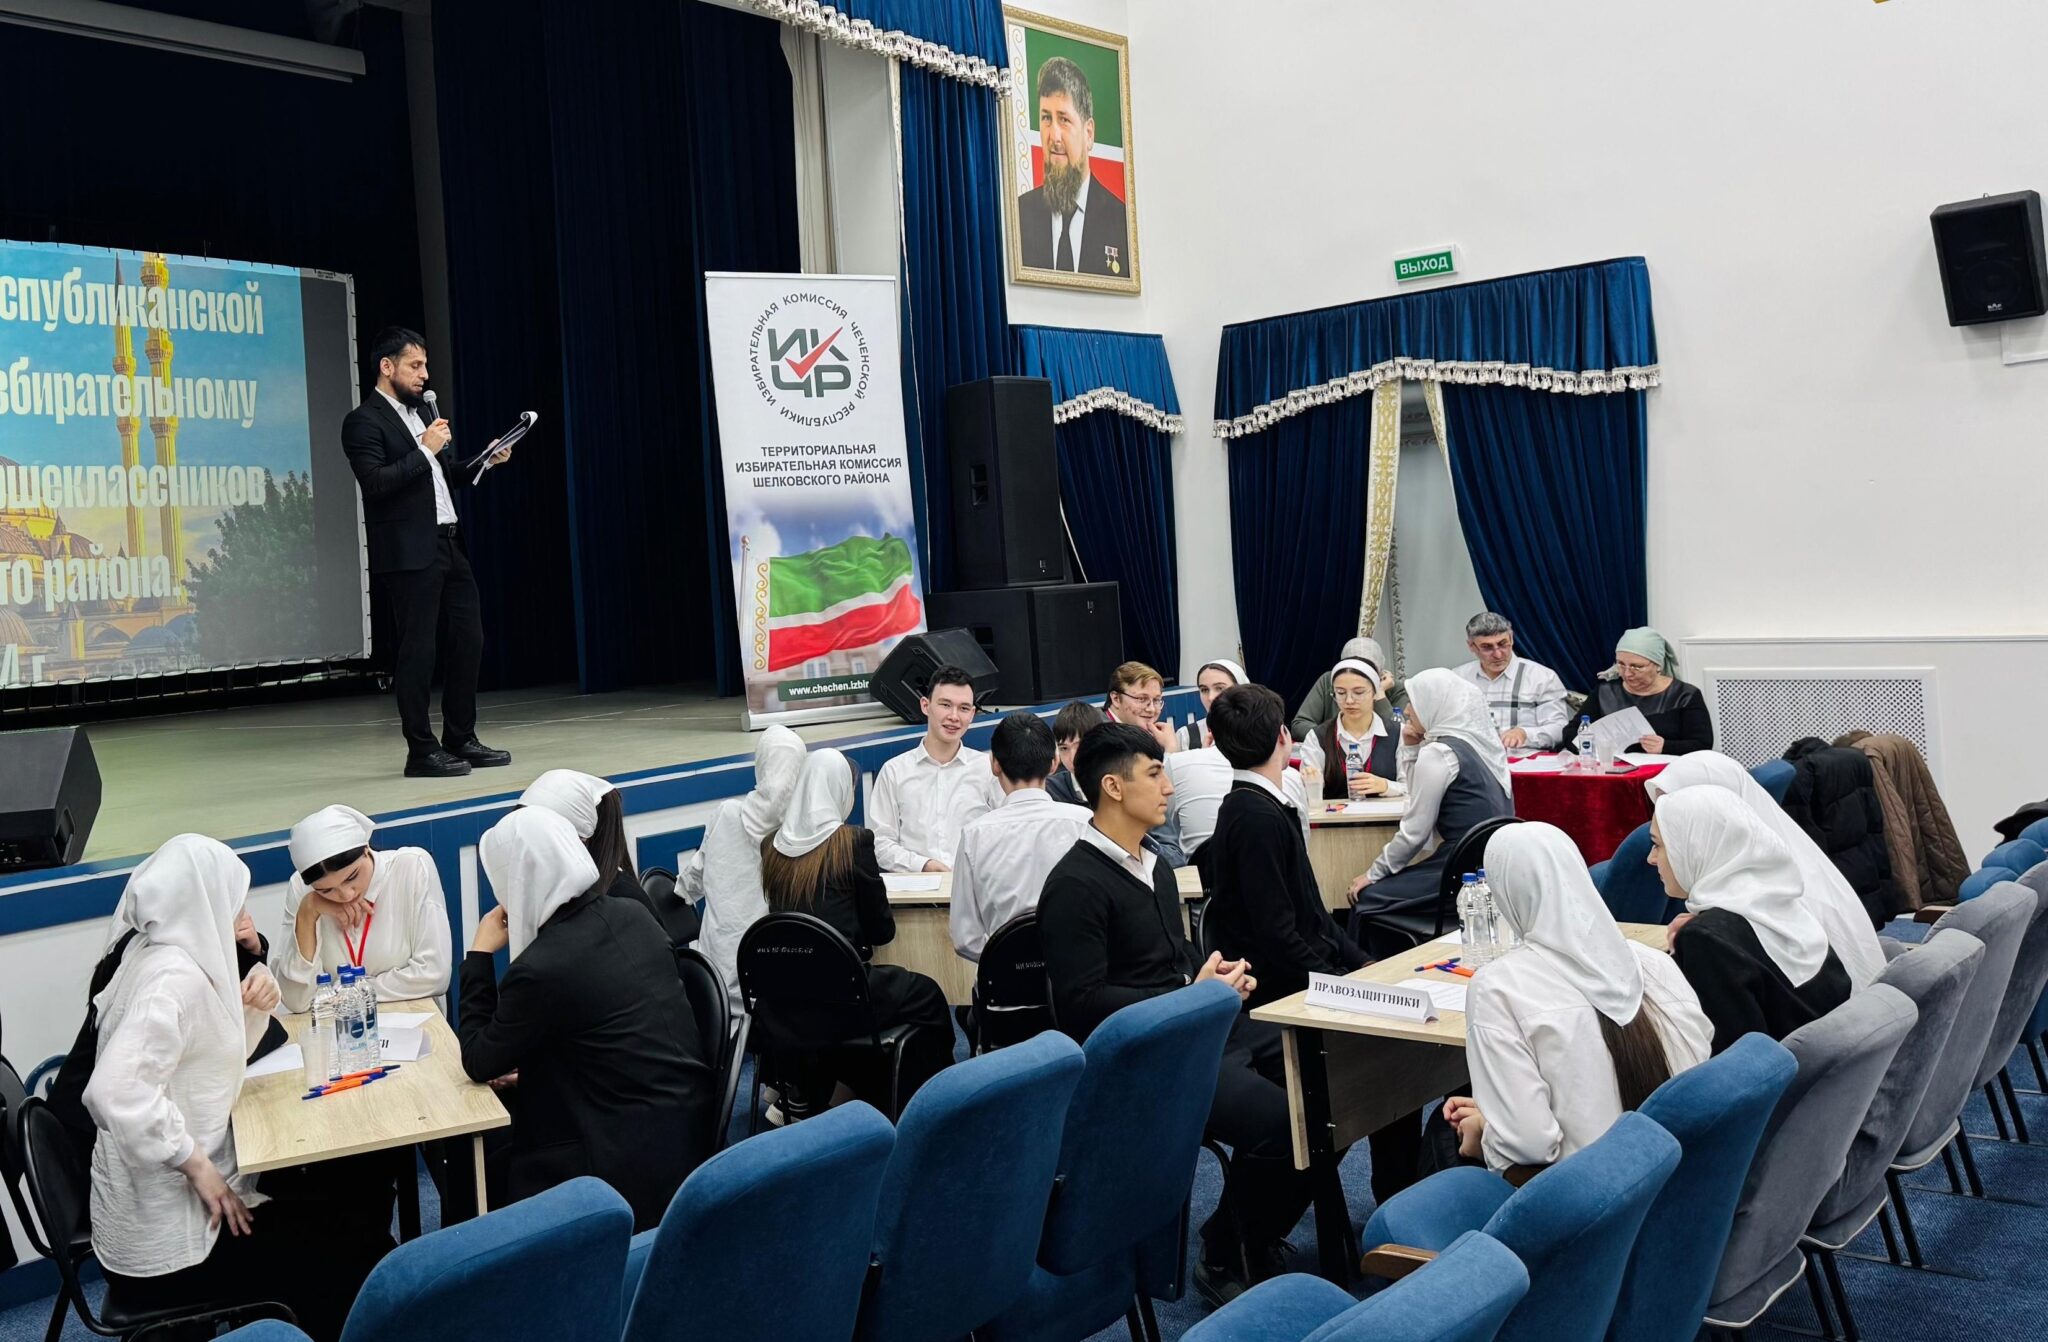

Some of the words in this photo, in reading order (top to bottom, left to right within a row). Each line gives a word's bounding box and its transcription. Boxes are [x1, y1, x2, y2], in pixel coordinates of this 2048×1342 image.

[1400, 256, 1448, 274] ВЫХОД
[0, 267, 264, 334] спубликанской
[782, 293, 848, 319] КОМИССИЯ
[750, 302, 779, 406] ИЗБИРАТЕЛЬНАЯ
[851, 321, 870, 400] ЧЕЧЕНСКОЙ
[780, 401, 856, 427] РЕСПУБЛИКИ
[761, 444, 876, 457] ТЕРРИТОРИАЛЬНАЯ
[735, 460, 836, 473] ИЗБИРАТЕЛЬНАЯ
[840, 458, 901, 470] КОМИССИЯ
[753, 474, 841, 488] ШЕЛКОВСКОГО
[844, 472, 890, 485] РАЙОНА
[44, 544, 181, 612] района.
[1315, 982, 1420, 1009] ПРАВОЗАЩИТНИКИ
